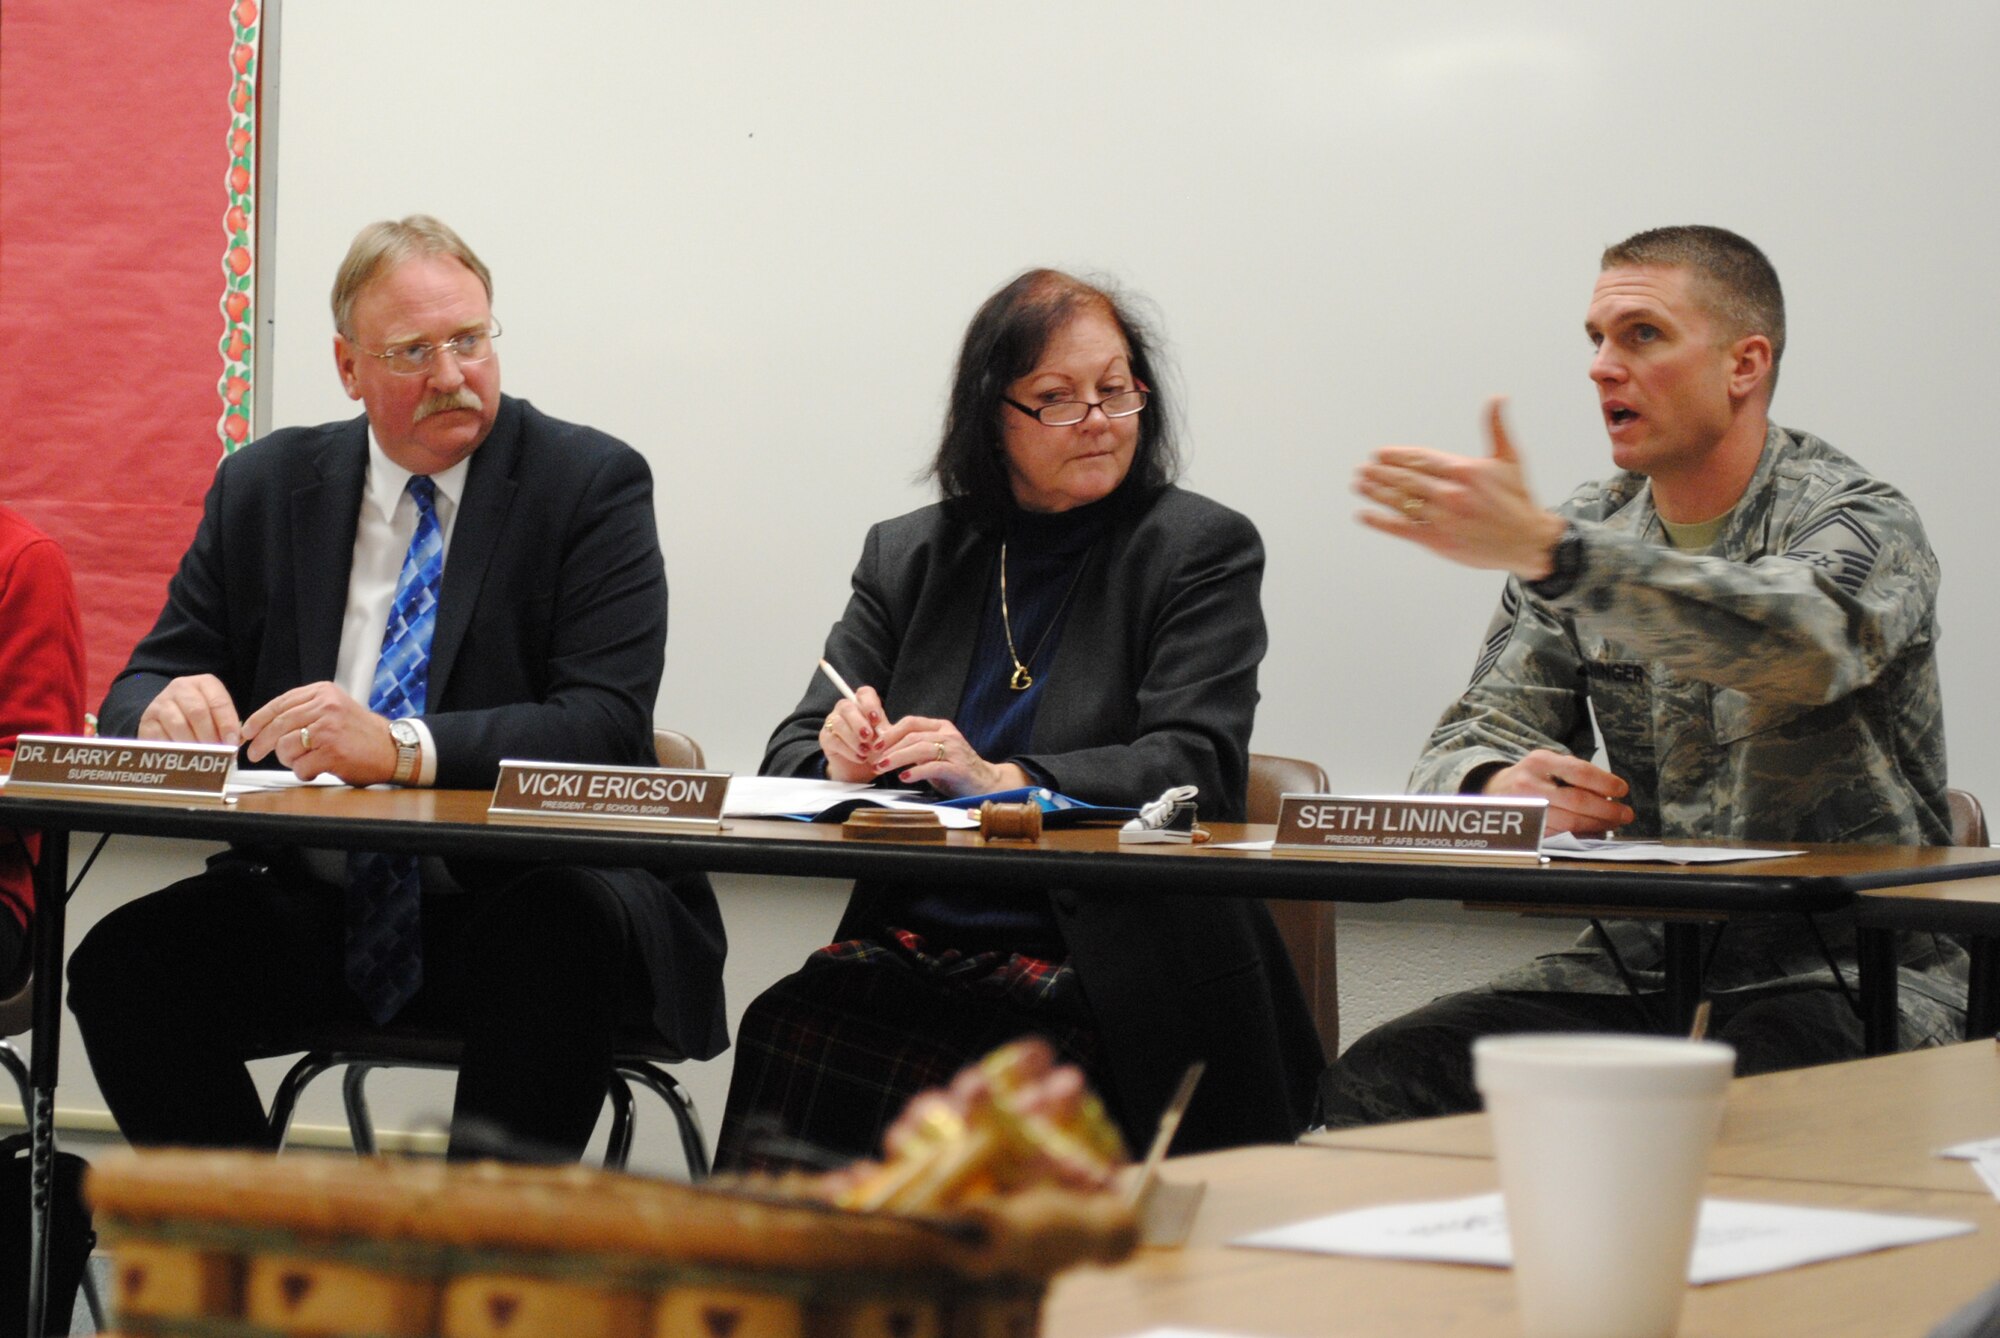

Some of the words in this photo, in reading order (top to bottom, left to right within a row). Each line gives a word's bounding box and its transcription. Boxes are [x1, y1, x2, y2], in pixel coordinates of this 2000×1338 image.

[17, 745, 47, 763] DR.
[53, 748, 114, 767] LARRY
[117, 751, 134, 769] P.
[139, 752, 228, 774] NYBLADH
[67, 768, 167, 784] SUPERINTENDENT
[517, 772, 583, 797] VICKI
[587, 776, 707, 803] ERICSON
[541, 800, 586, 811] PRESIDENT
[606, 804, 639, 813] SCHOOL
[640, 806, 670, 815] BOARD
[1297, 805, 1376, 831] SETH
[1382, 807, 1524, 835] LININGER
[1324, 835, 1376, 846] PRESIDENT
[1382, 836, 1413, 847] GFAFB
[1414, 837, 1453, 848] SCHOOL
[1454, 838, 1488, 849] BOARD
